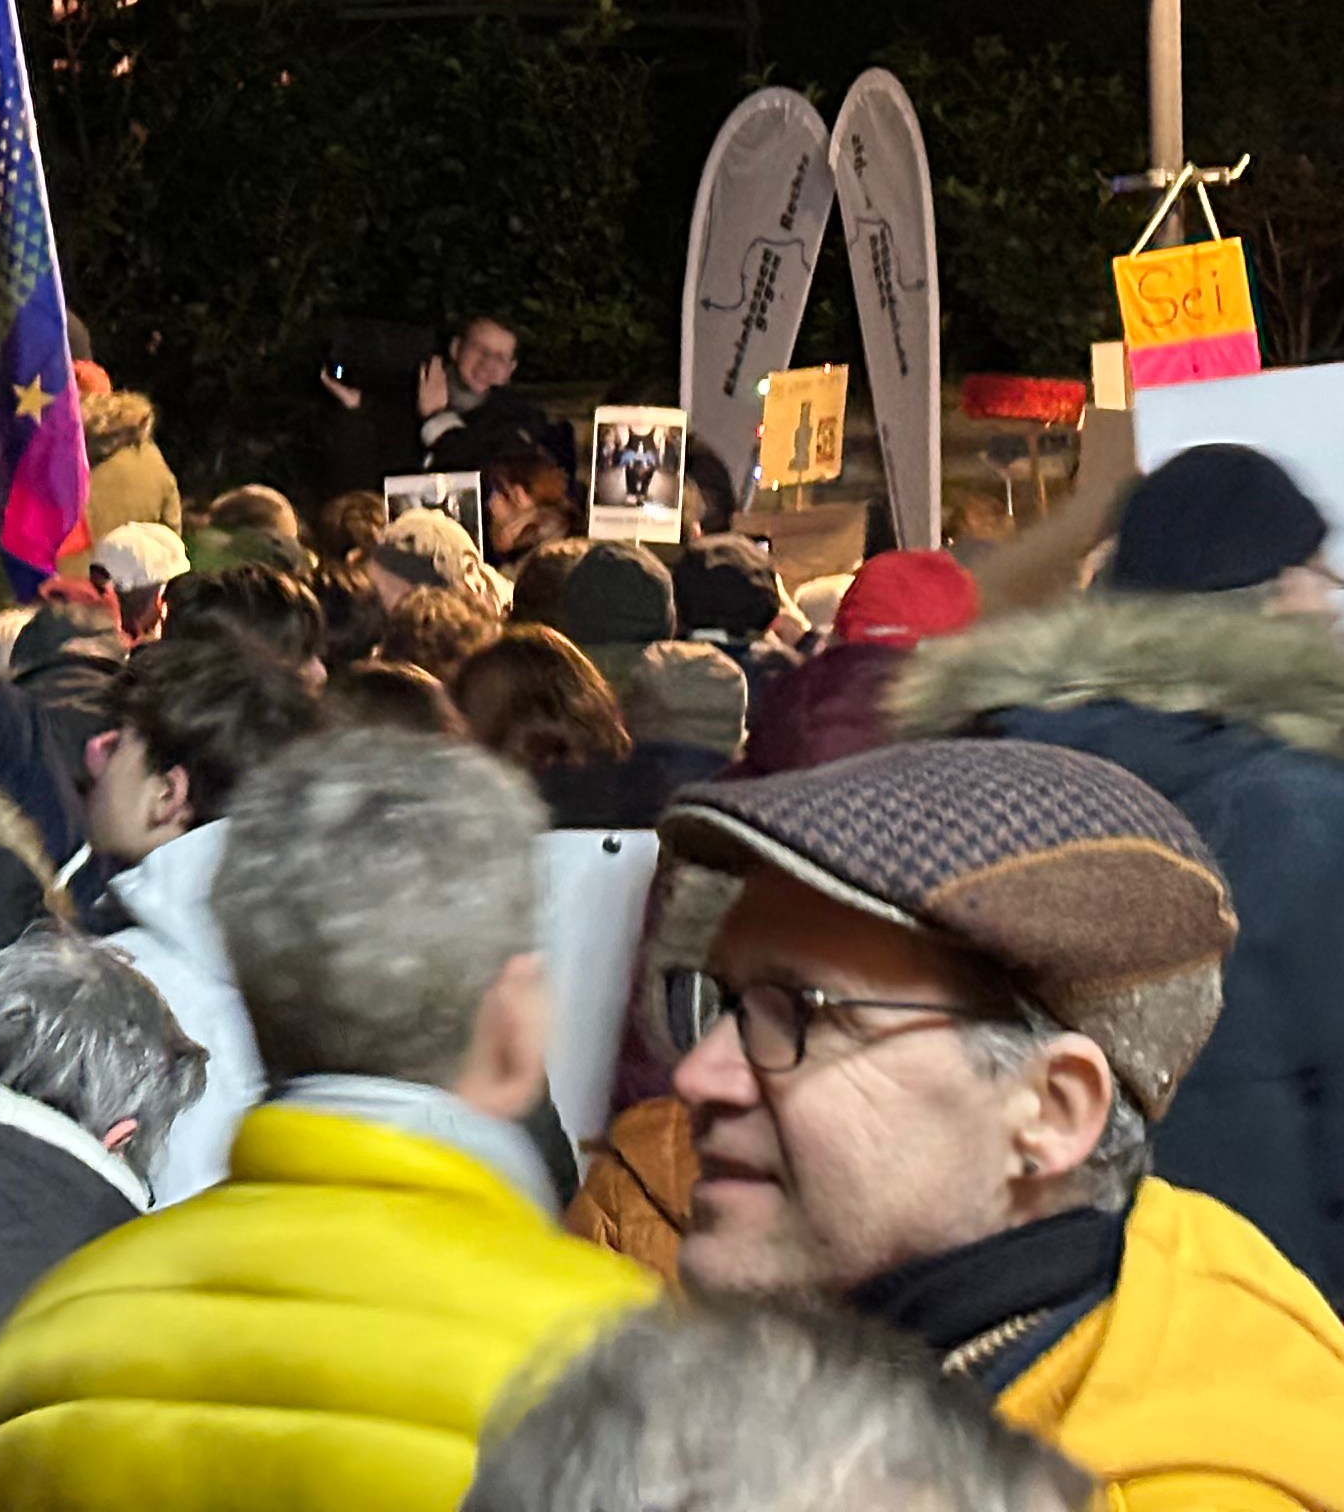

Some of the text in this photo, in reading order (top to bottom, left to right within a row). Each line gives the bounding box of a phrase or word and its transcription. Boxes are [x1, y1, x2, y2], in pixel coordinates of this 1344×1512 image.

[780, 154, 810, 231] Rechts
[723, 247, 773, 399] Rheinhessen
[756, 253, 782, 333] gegen
